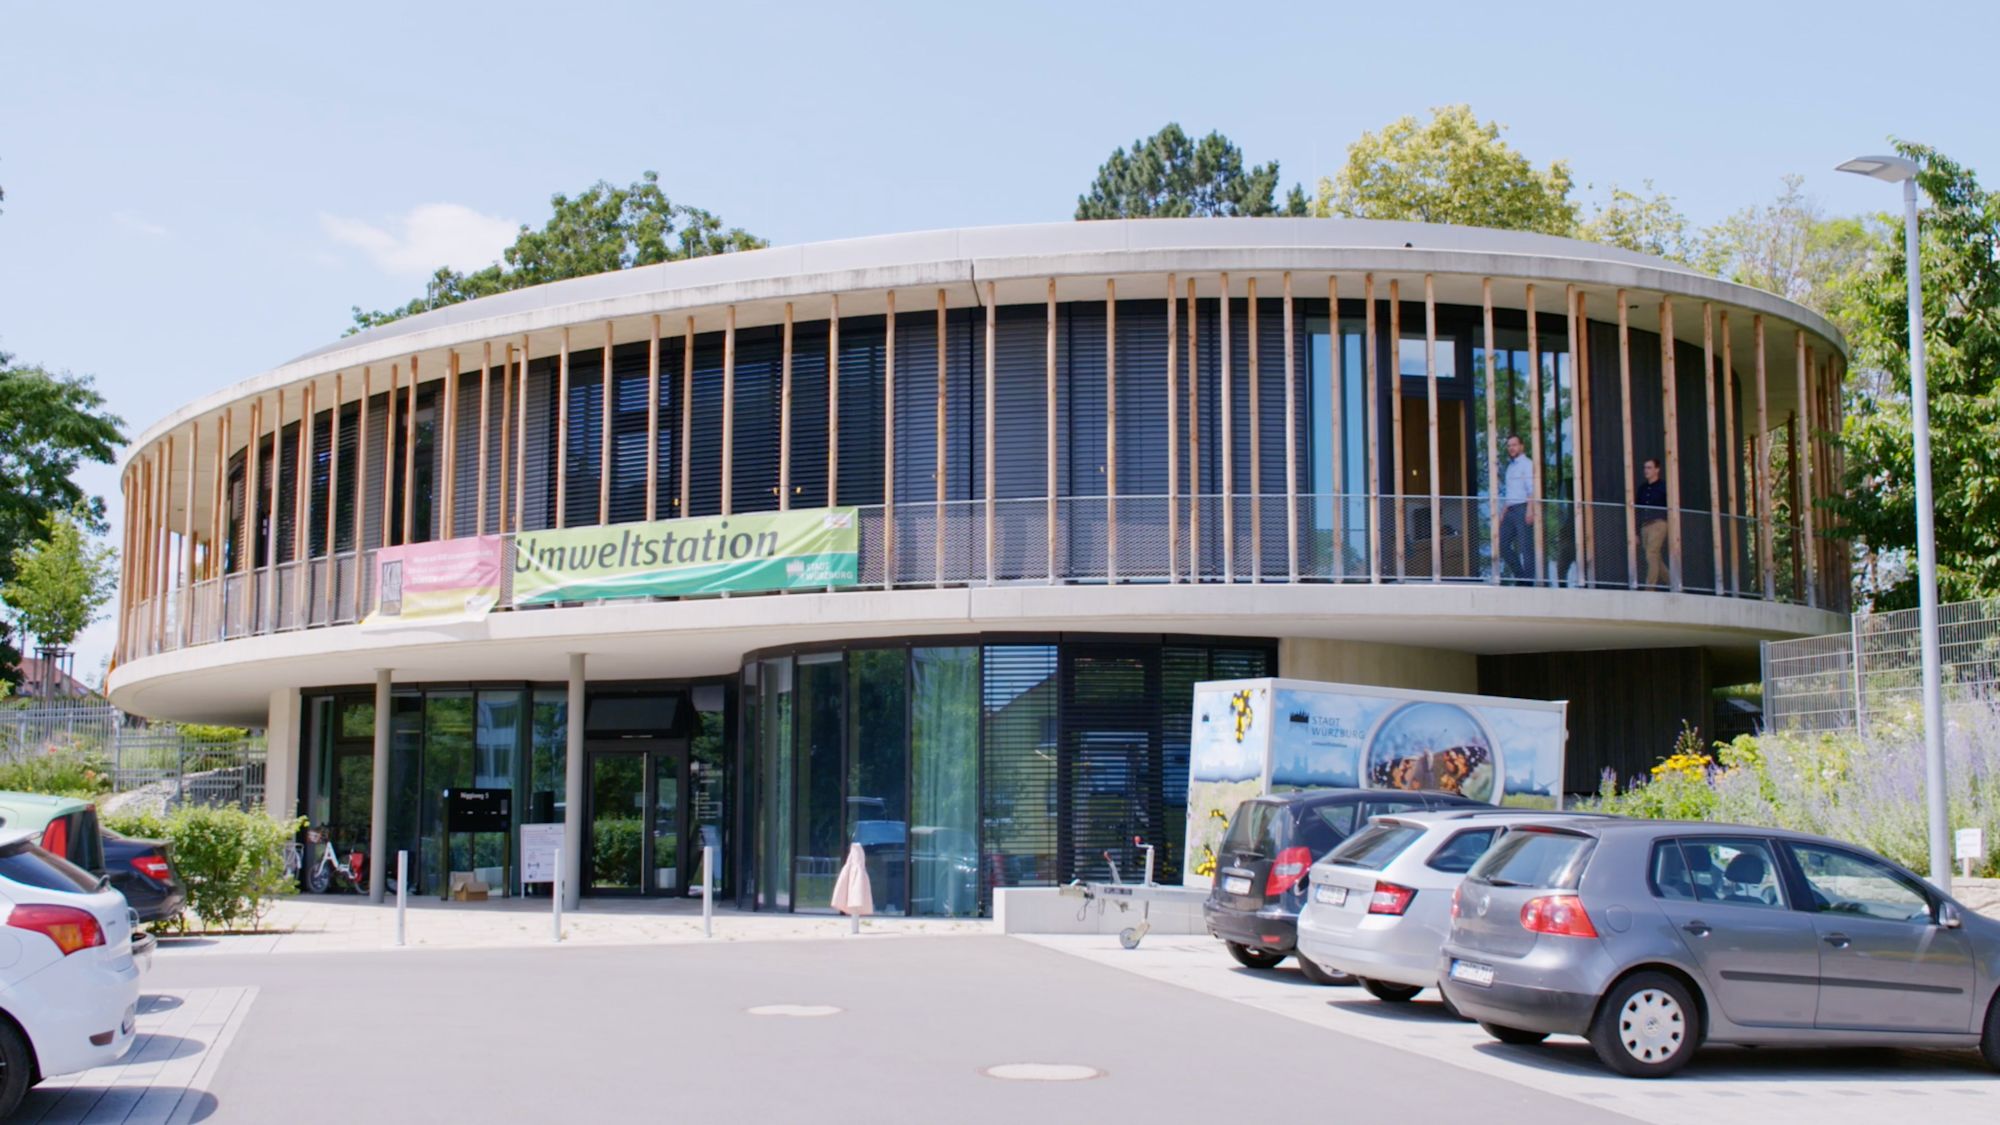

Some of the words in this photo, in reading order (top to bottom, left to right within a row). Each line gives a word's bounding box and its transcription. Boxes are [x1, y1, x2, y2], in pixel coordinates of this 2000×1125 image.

[514, 520, 779, 573] Umweltstation
[1312, 716, 1340, 727] STADT
[1312, 727, 1365, 739] WÜRZBURG
